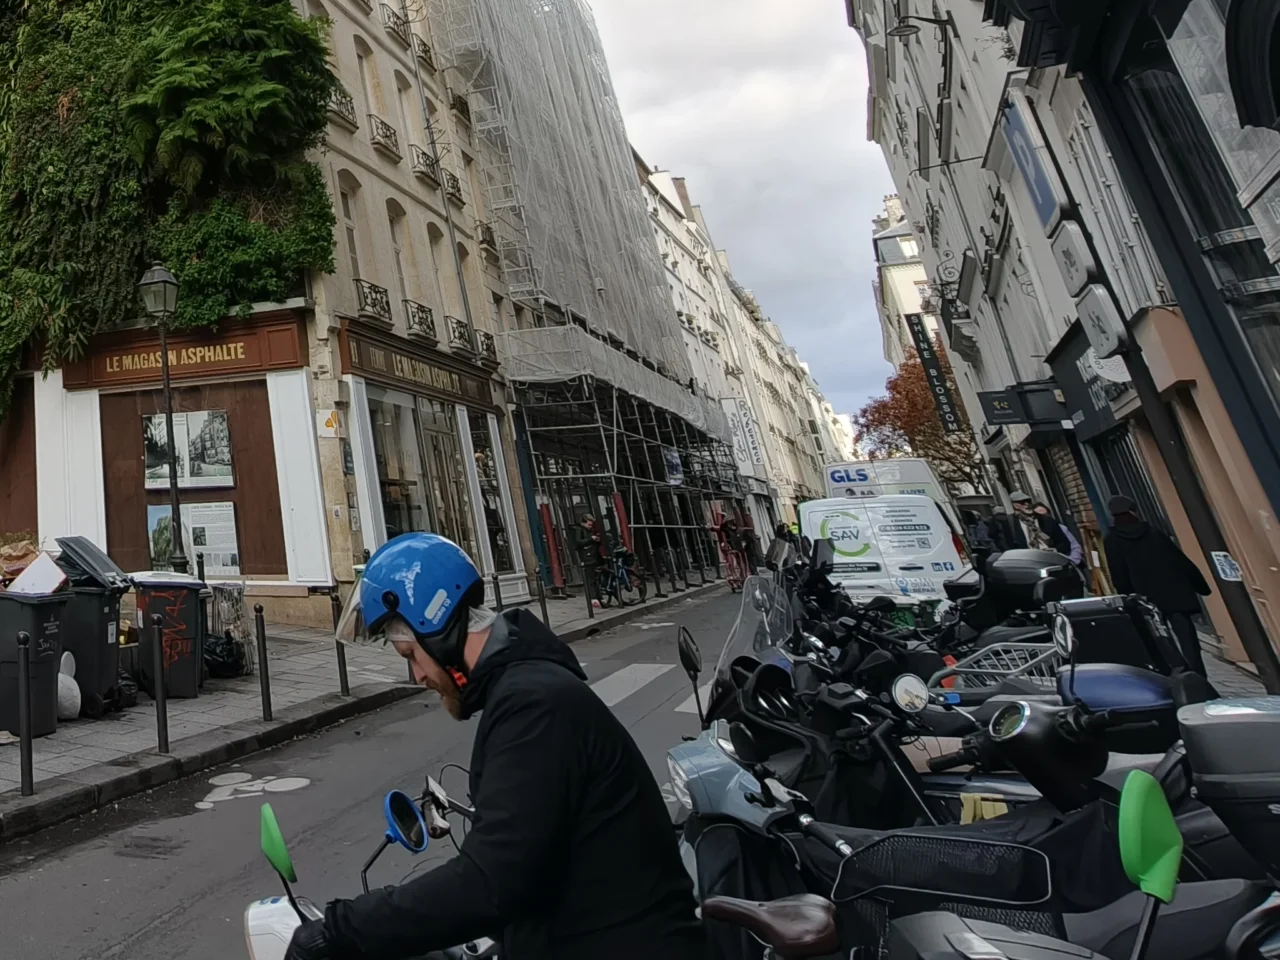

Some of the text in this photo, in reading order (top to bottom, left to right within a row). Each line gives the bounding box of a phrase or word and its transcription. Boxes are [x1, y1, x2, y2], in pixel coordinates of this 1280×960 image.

[1014, 129, 1042, 204] P
[106, 342, 246, 373] LE MAGASN ASPHALTE
[392, 352, 404, 377] LE
[401, 356, 433, 386] MAGASIN
[910, 315, 959, 431] SHINE BLOSSOM
[830, 468, 869, 483] GLS
[830, 529, 860, 542] SAV
